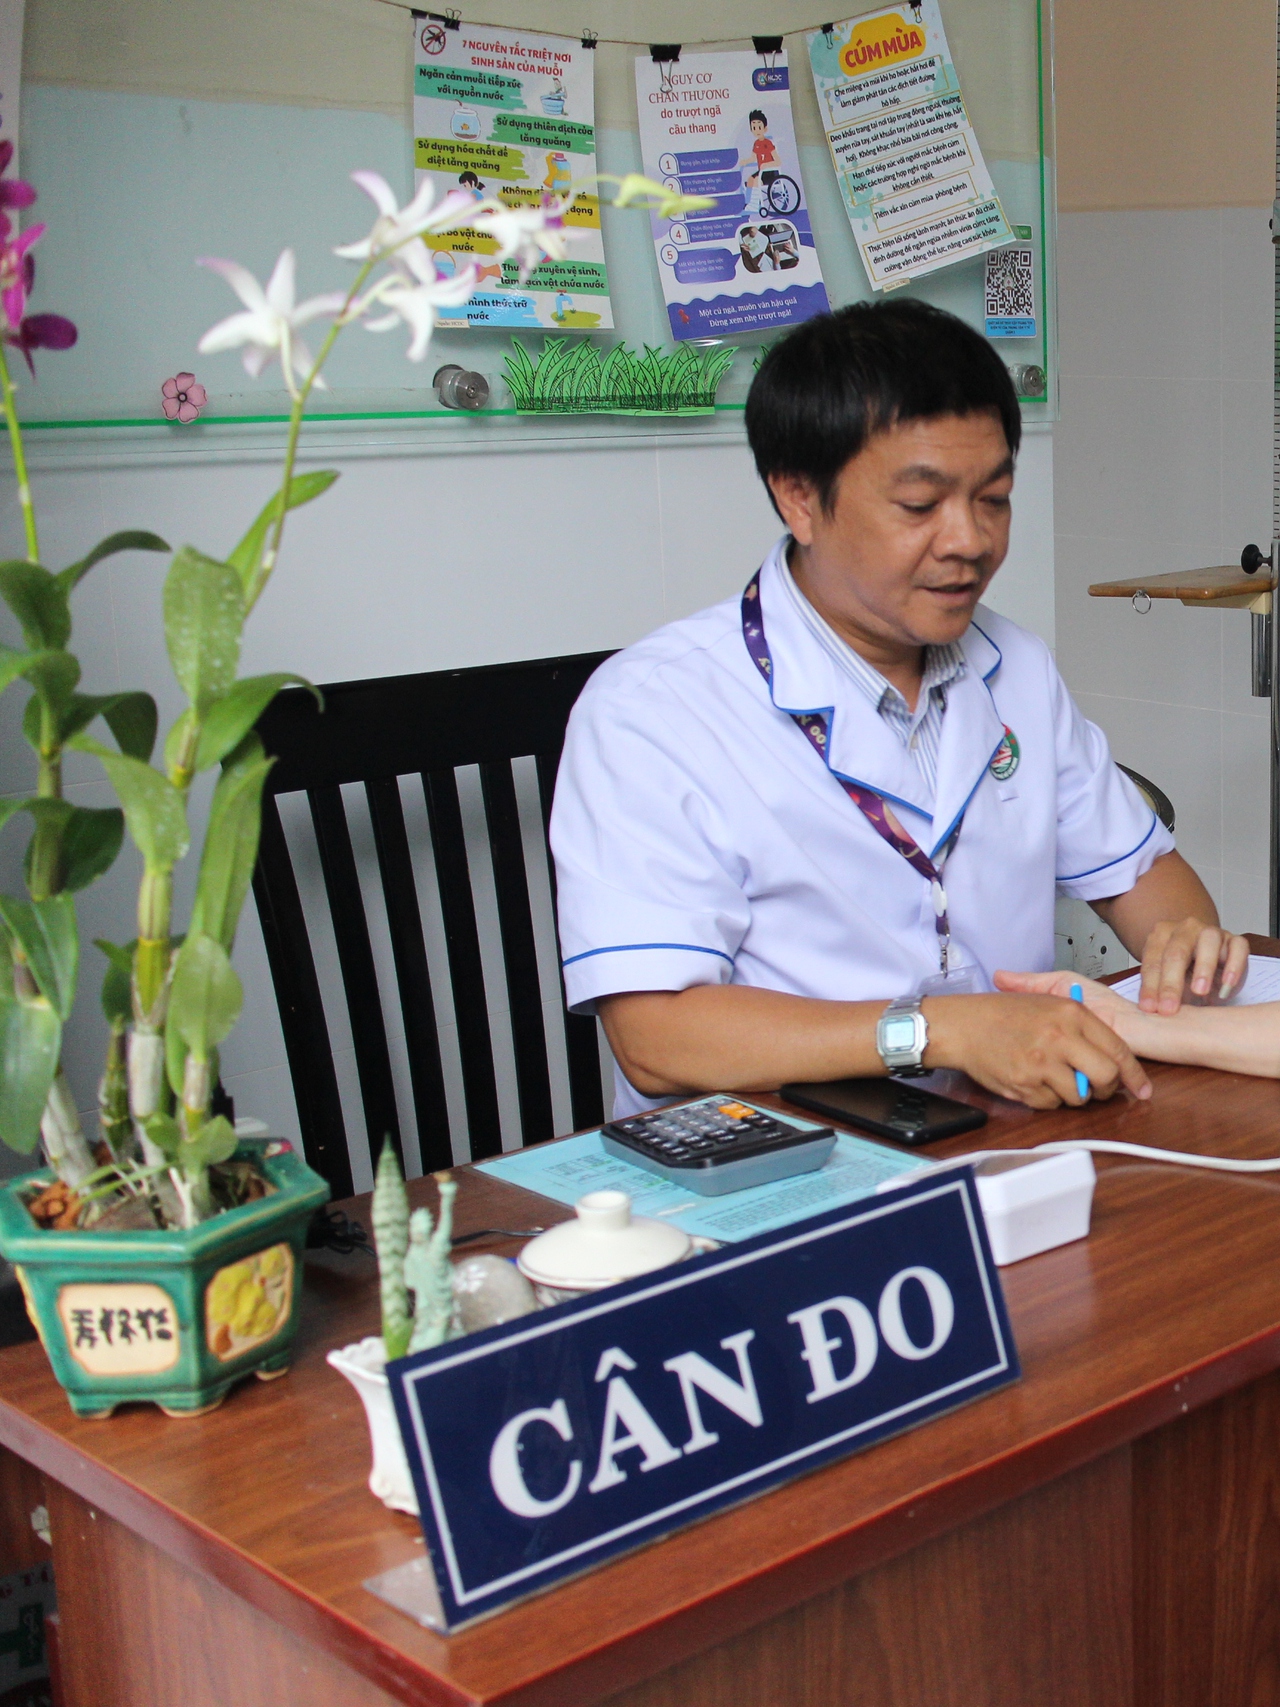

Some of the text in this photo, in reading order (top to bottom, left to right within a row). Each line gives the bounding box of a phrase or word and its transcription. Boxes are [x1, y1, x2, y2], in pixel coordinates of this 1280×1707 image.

[463, 40, 571, 63] 7 NGUYÊN TẮC TRIỆT NƠI
[845, 27, 922, 68] CÚM MÙA
[471, 56, 562, 76] SINH SẢN CỦA MUỖI
[420, 68, 521, 88] Ngăn cản muỗi tiếp xúc
[664, 73, 712, 86] NGUY CƠ
[437, 85, 503, 101] với nguồn nước
[681, 88, 729, 101] THƯƠNG
[661, 105, 721, 119] do trượt ngã
[497, 116, 508, 126] Sử
[509, 119, 532, 131] dụng
[534, 122, 556, 131] thiên
[578, 126, 593, 135] của
[669, 123, 716, 135] cầu thang
[520, 133, 571, 148] lăng quăng
[418, 139, 430, 149] Sử
[431, 142, 455, 154] dụng
[456, 144, 474, 154] hóa
[476, 144, 496, 156] chất
[427, 156, 500, 172] diệt lăng quăng
[666, 160, 671, 169] 1
[577, 192, 587, 201] có
[460, 229, 475, 240] vật
[676, 230, 681, 238] 4
[667, 251, 673, 260] 5
[539, 266, 566, 275] xuyên
[567, 266, 577, 277] vệ
[578, 267, 600, 277] sinh,
[501, 276, 519, 285] làm
[526, 280, 542, 288] ạch
[543, 279, 558, 288] vật
[560, 279, 582, 287] chứa
[491, 299, 512, 307] thức
[513, 300, 527, 308] trữ
[467, 312, 489, 320] nước
[490, 1266, 954, 1519] CÂN ĐO
